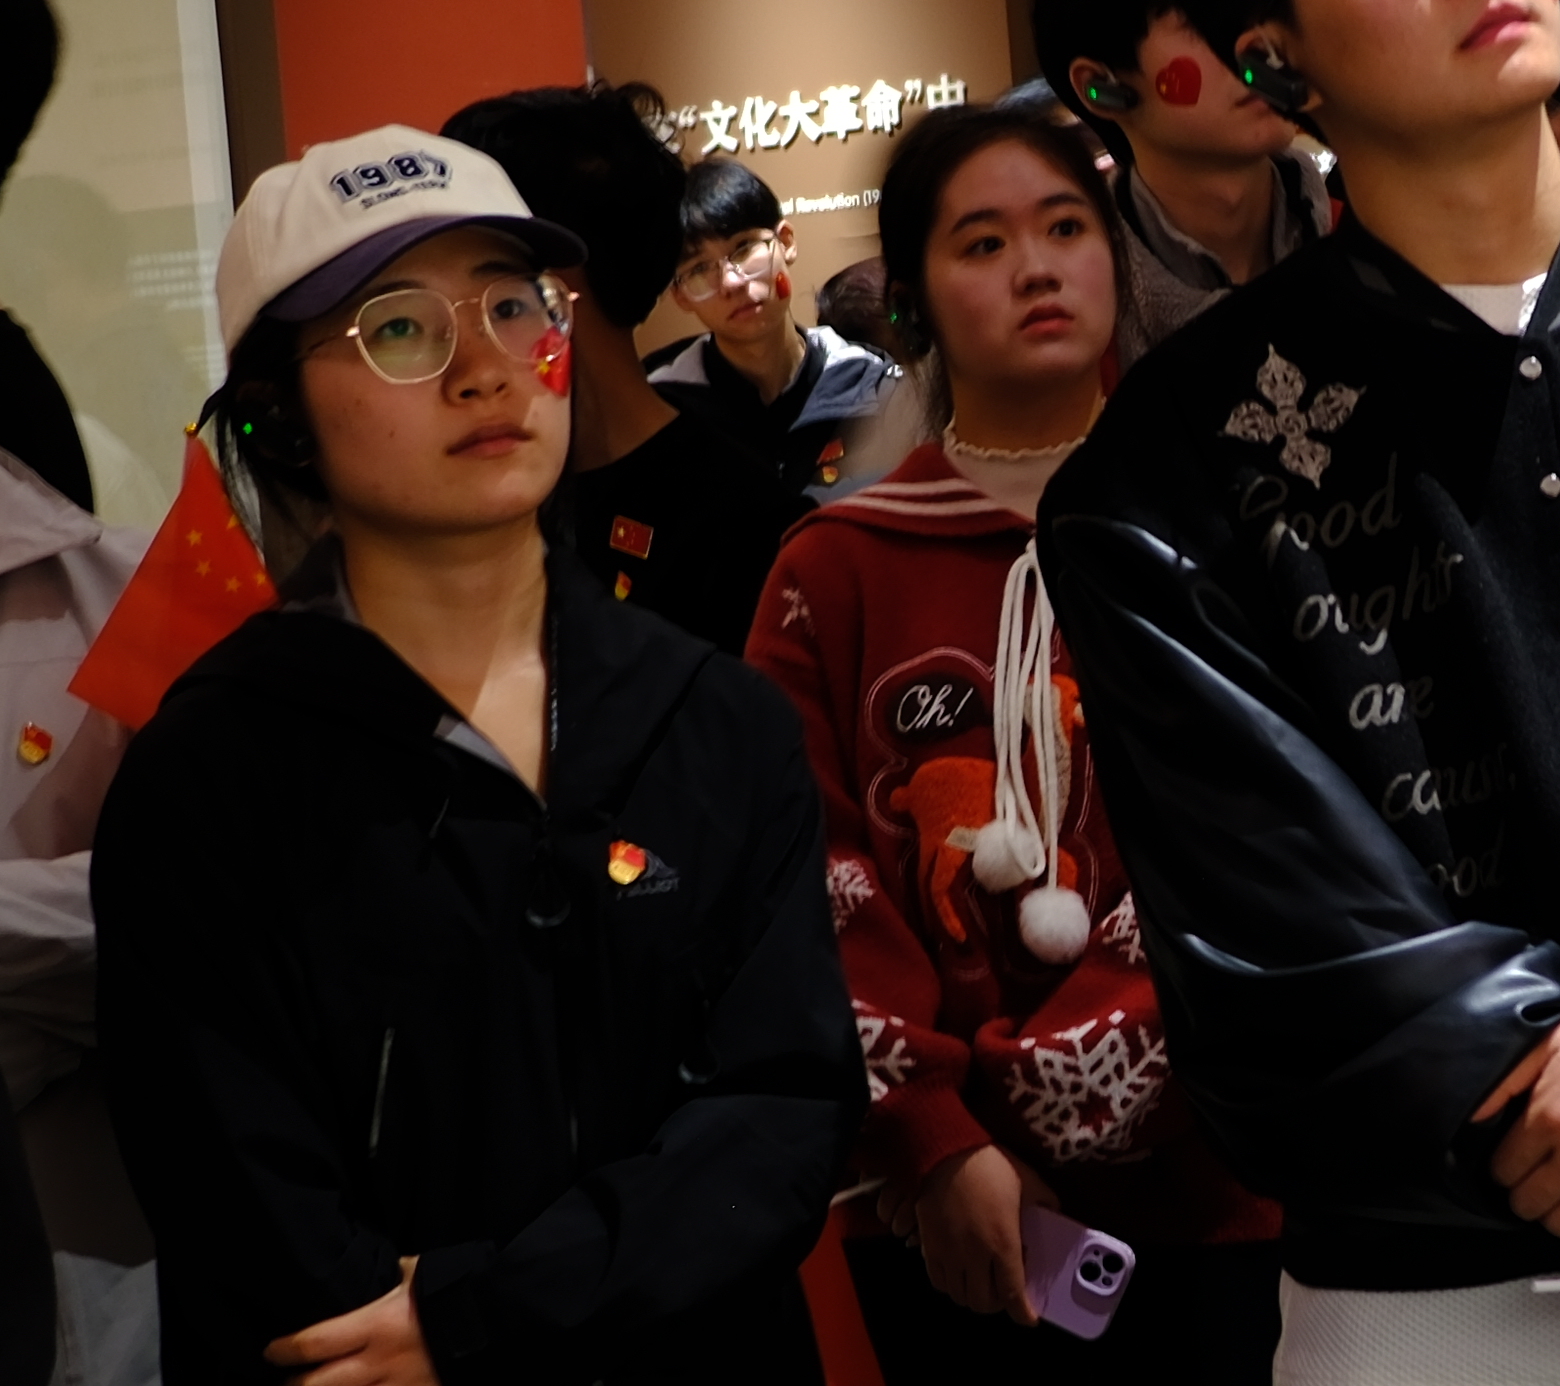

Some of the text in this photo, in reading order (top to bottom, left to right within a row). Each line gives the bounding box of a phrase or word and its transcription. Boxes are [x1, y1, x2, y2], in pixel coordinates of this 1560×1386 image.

[653, 73, 967, 157] “文化大革命”中
[329, 149, 453, 203] 1987
[897, 684, 974, 733] Oh!
[1347, 674, 1437, 731] are
